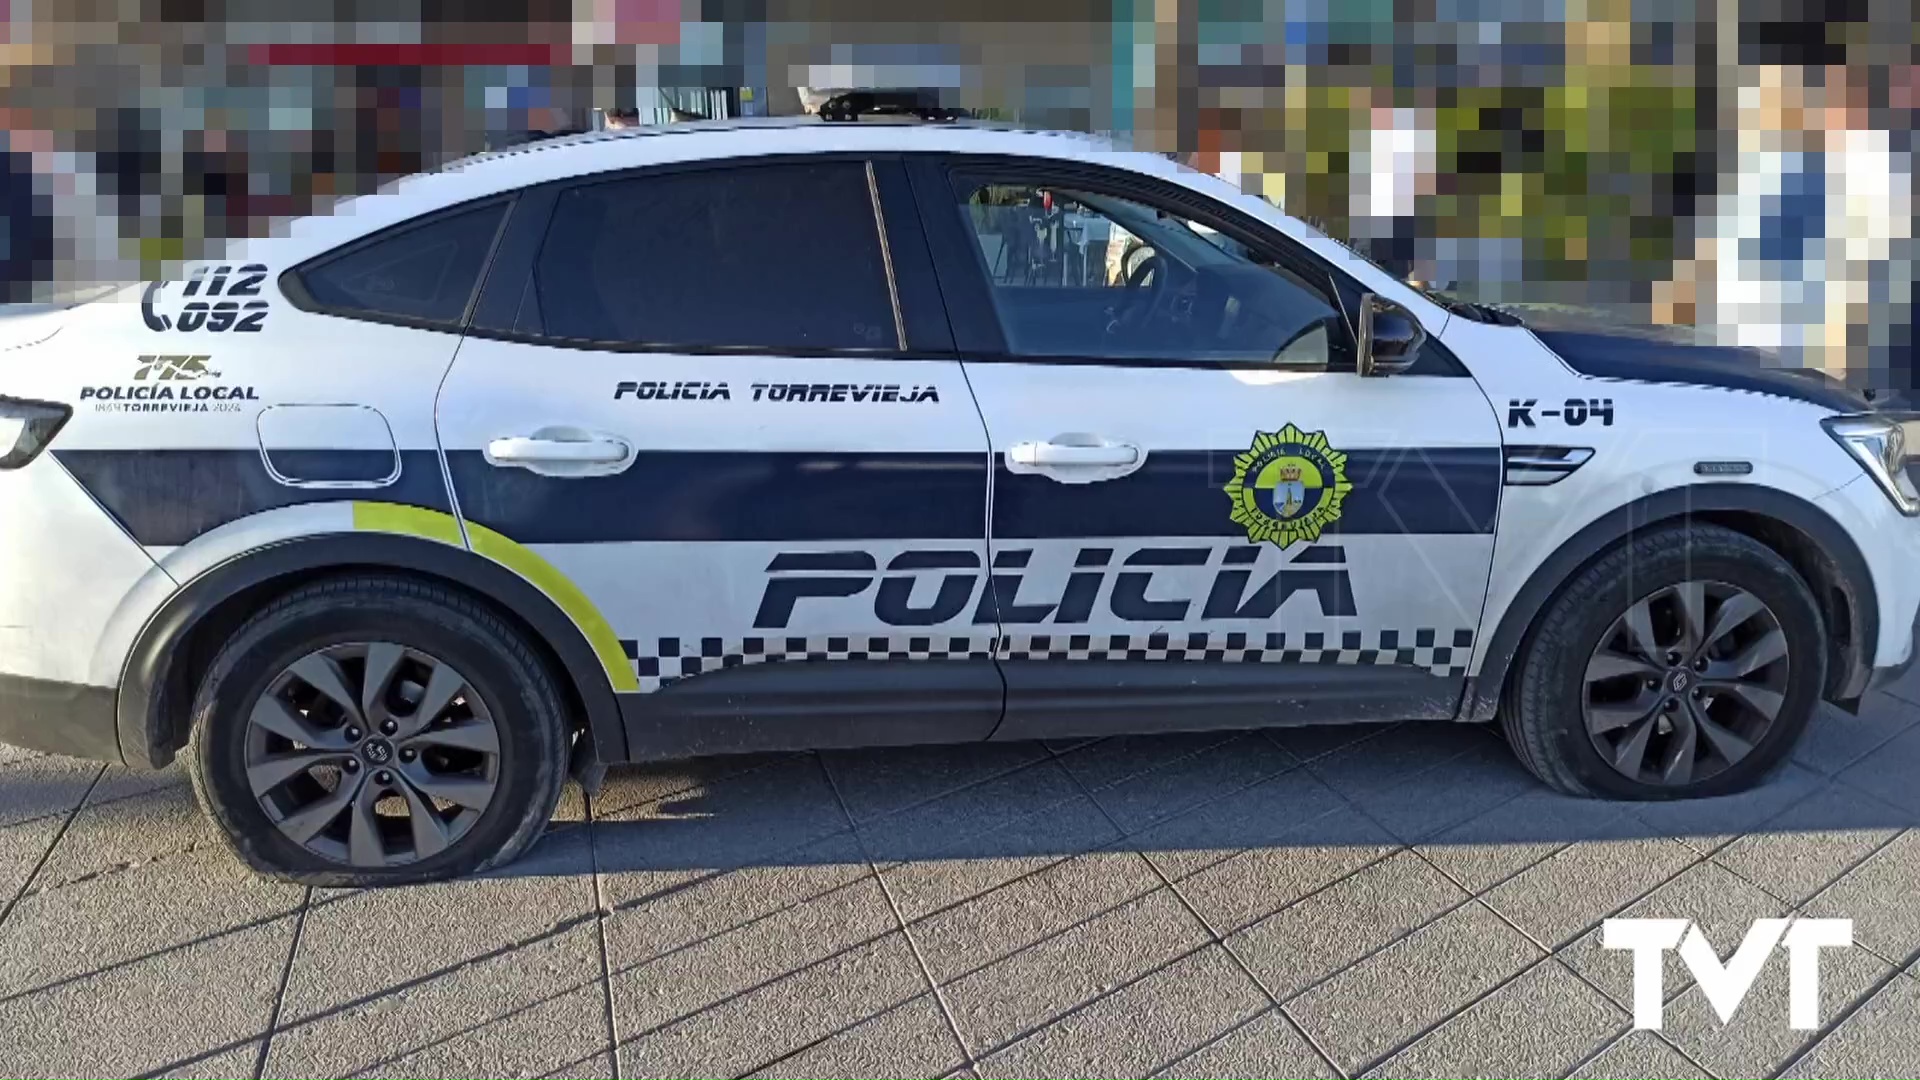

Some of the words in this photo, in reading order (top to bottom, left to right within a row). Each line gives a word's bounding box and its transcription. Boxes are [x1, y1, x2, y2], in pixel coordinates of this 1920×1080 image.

[183, 263, 268, 296] 112
[176, 301, 269, 332] 092
[80, 383, 174, 400] POLICÍA
[180, 386, 259, 400] LOCAL
[613, 381, 732, 400] POLICIA
[750, 383, 940, 402] TORREVIEJA
[123, 403, 209, 412] TORREVIEJA
[1507, 398, 1615, 428] K-04
[752, 545, 1358, 628] POLICIA
